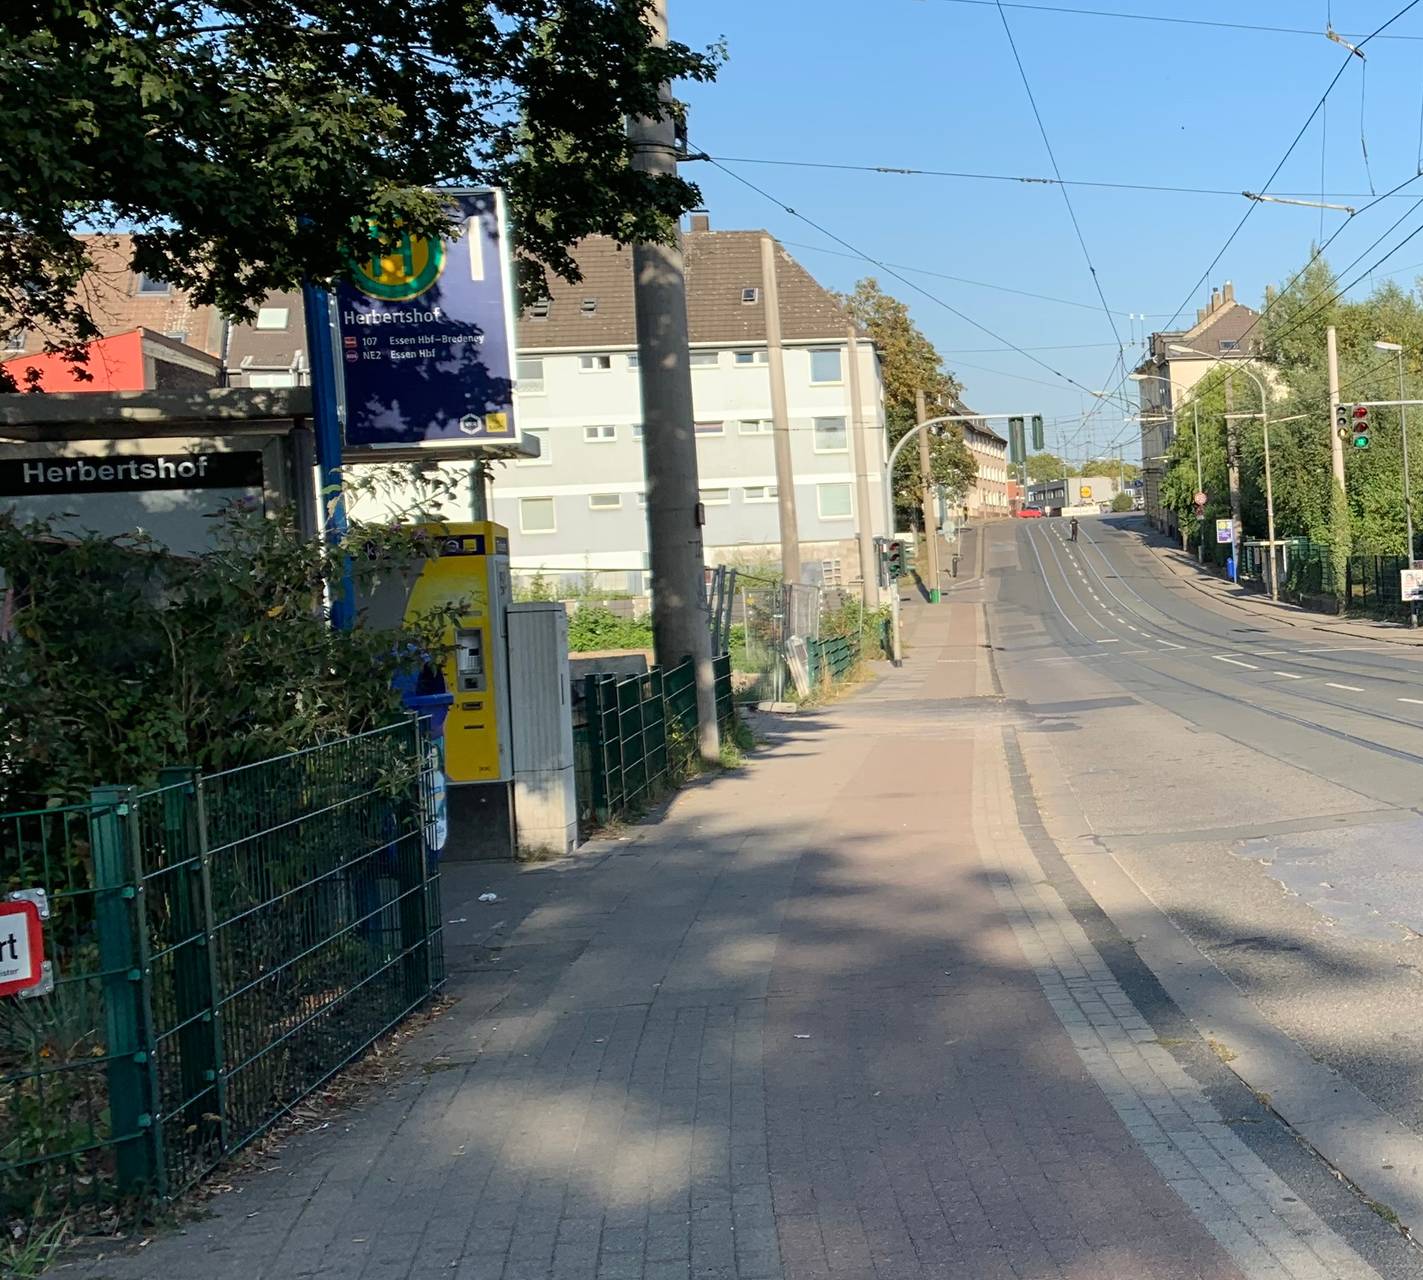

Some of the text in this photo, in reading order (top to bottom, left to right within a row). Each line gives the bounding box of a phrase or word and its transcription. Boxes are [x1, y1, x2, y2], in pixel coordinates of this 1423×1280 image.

[464, 215, 485, 281] 1
[344, 307, 441, 325] Herbertshof
[362, 337, 377, 346] 107
[389, 336, 416, 345] Essen
[363, 350, 382, 360] NE2
[390, 350, 417, 359] Essen
[419, 348, 436, 358] Hbf
[23, 456, 208, 483] Herbertshof
